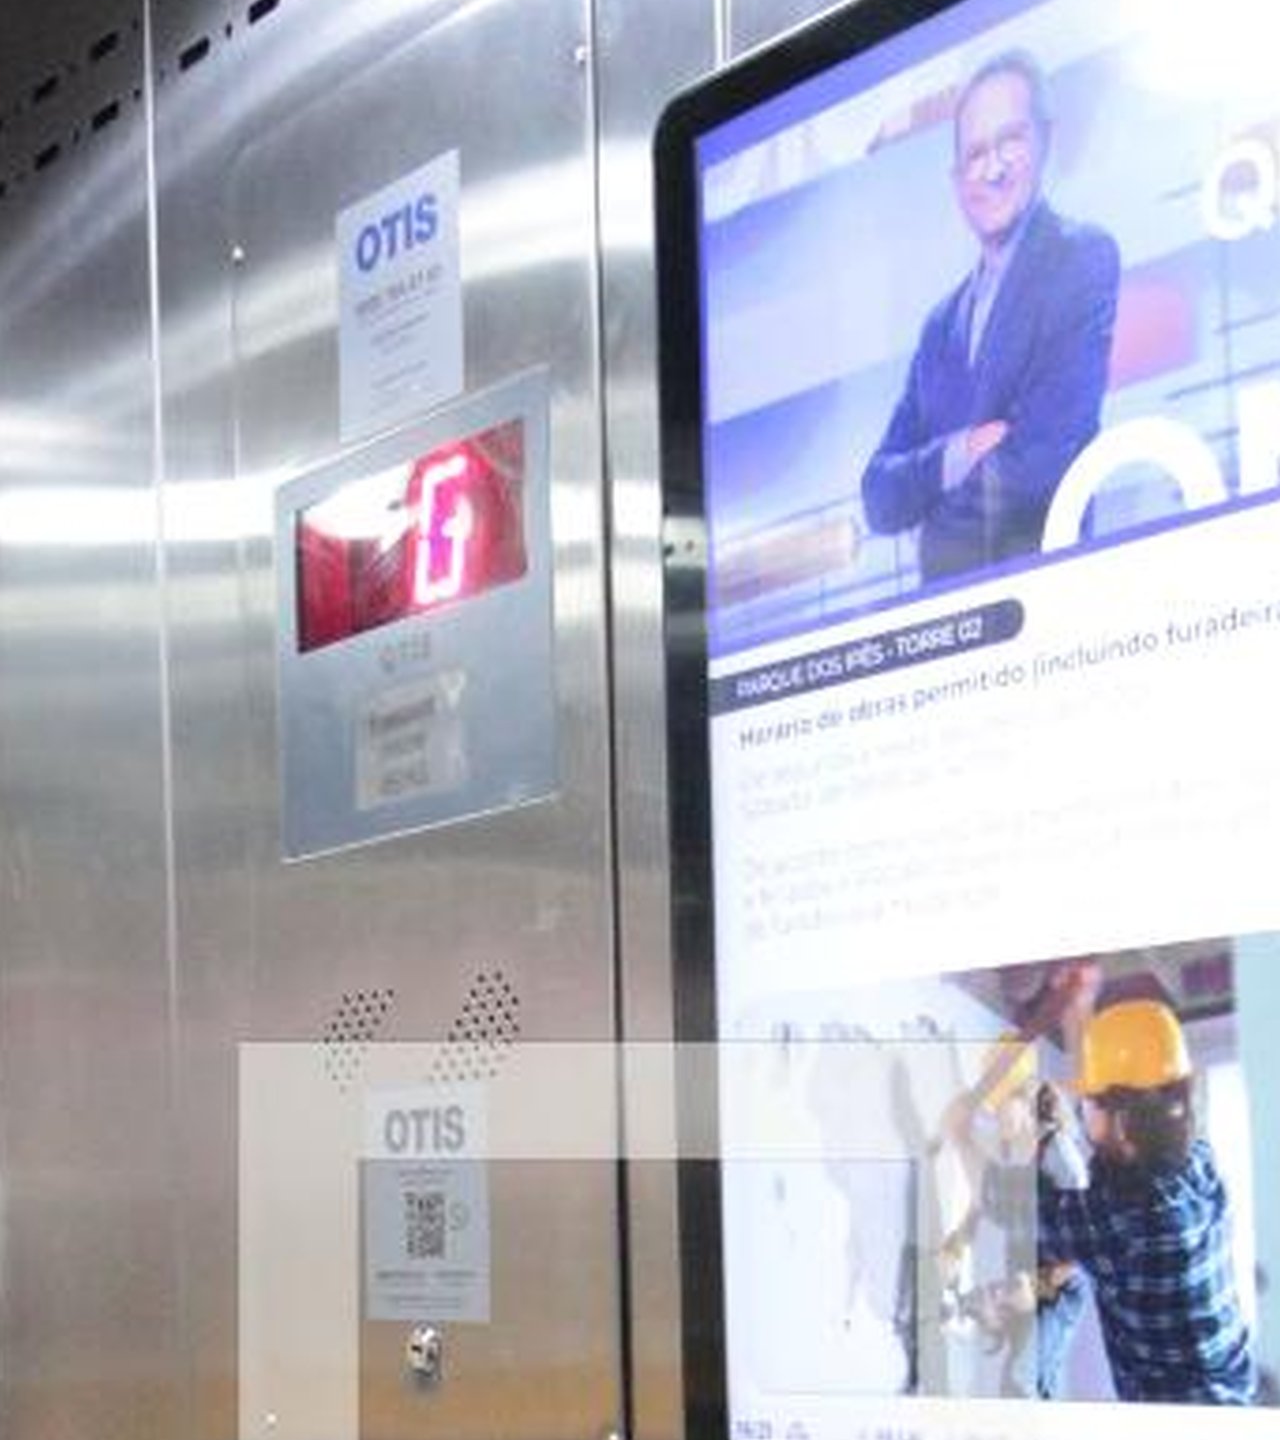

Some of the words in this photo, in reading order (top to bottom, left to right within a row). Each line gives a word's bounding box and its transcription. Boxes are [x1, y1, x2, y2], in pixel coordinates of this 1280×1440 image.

[356, 193, 439, 273] OTIS
[895, 622, 957, 657] TORRE
[913, 662, 1025, 712] permitido
[384, 1105, 465, 1155] OTIS
